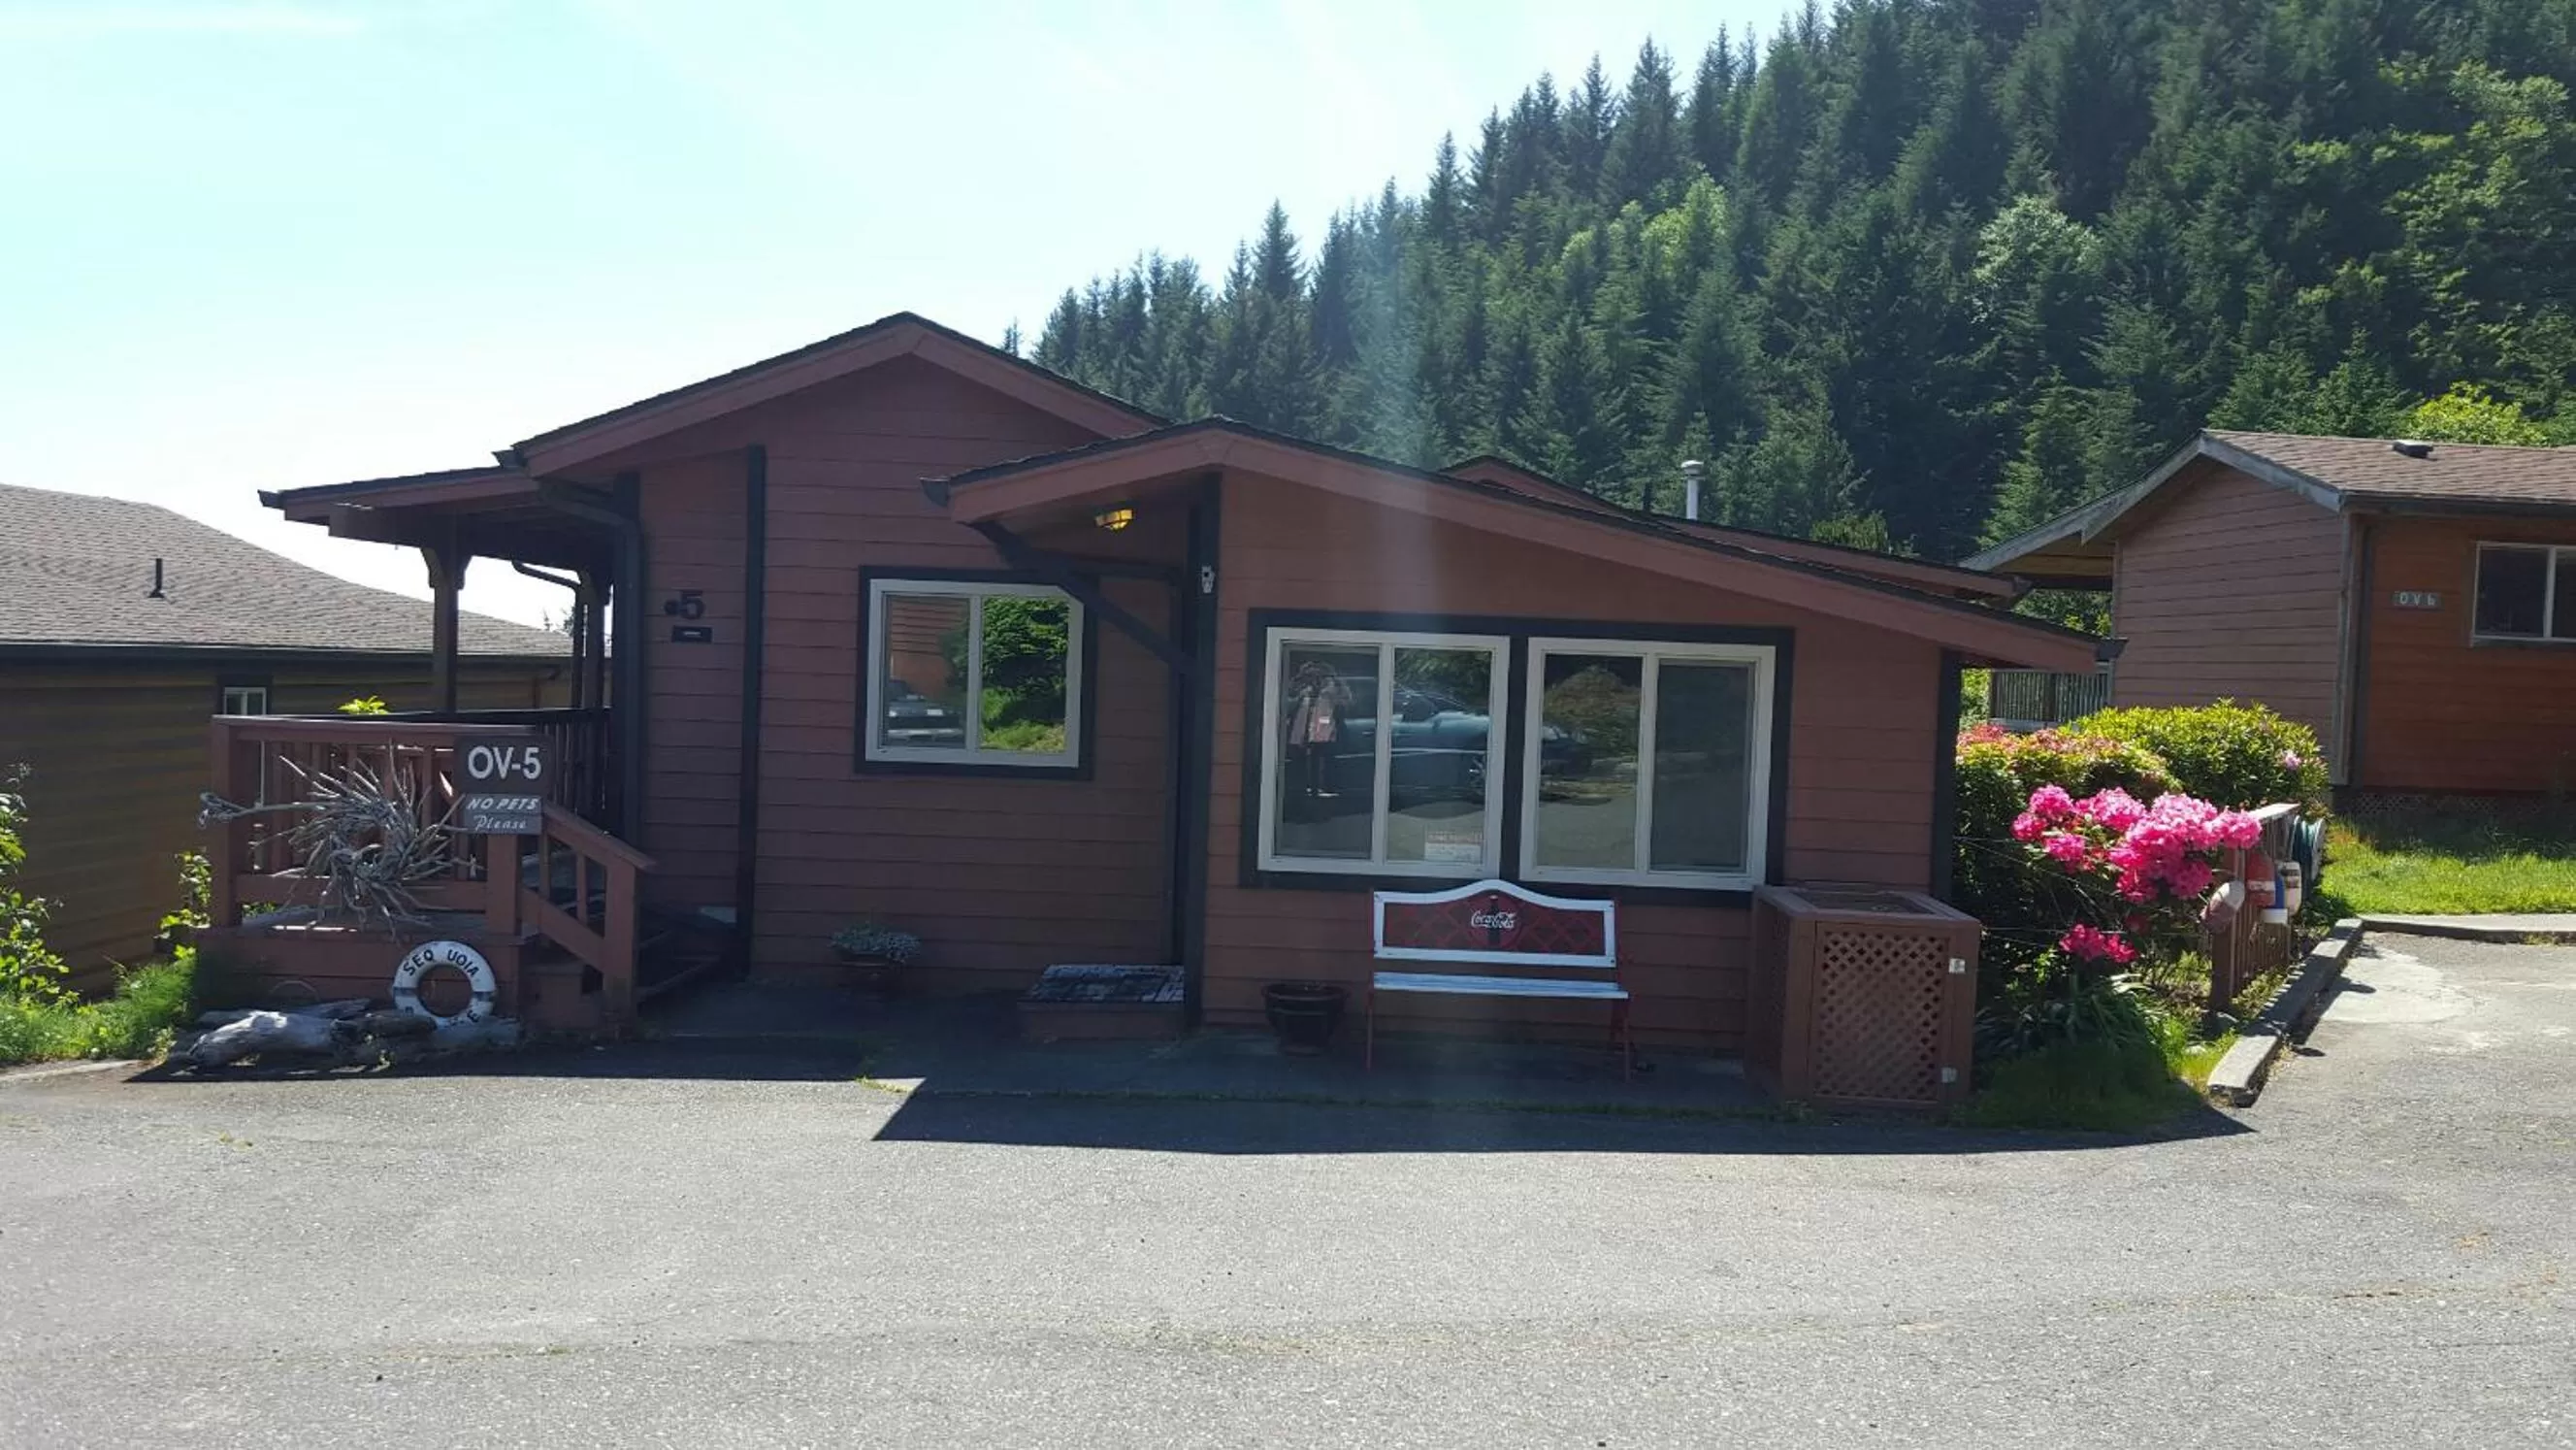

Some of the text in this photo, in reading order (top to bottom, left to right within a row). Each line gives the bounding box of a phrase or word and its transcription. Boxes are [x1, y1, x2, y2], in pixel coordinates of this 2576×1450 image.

[679, 590, 706, 620] 5
[467, 744, 542, 779] OV-5
[466, 797, 538, 810] NO PETS
[473, 814, 527, 832] Please
